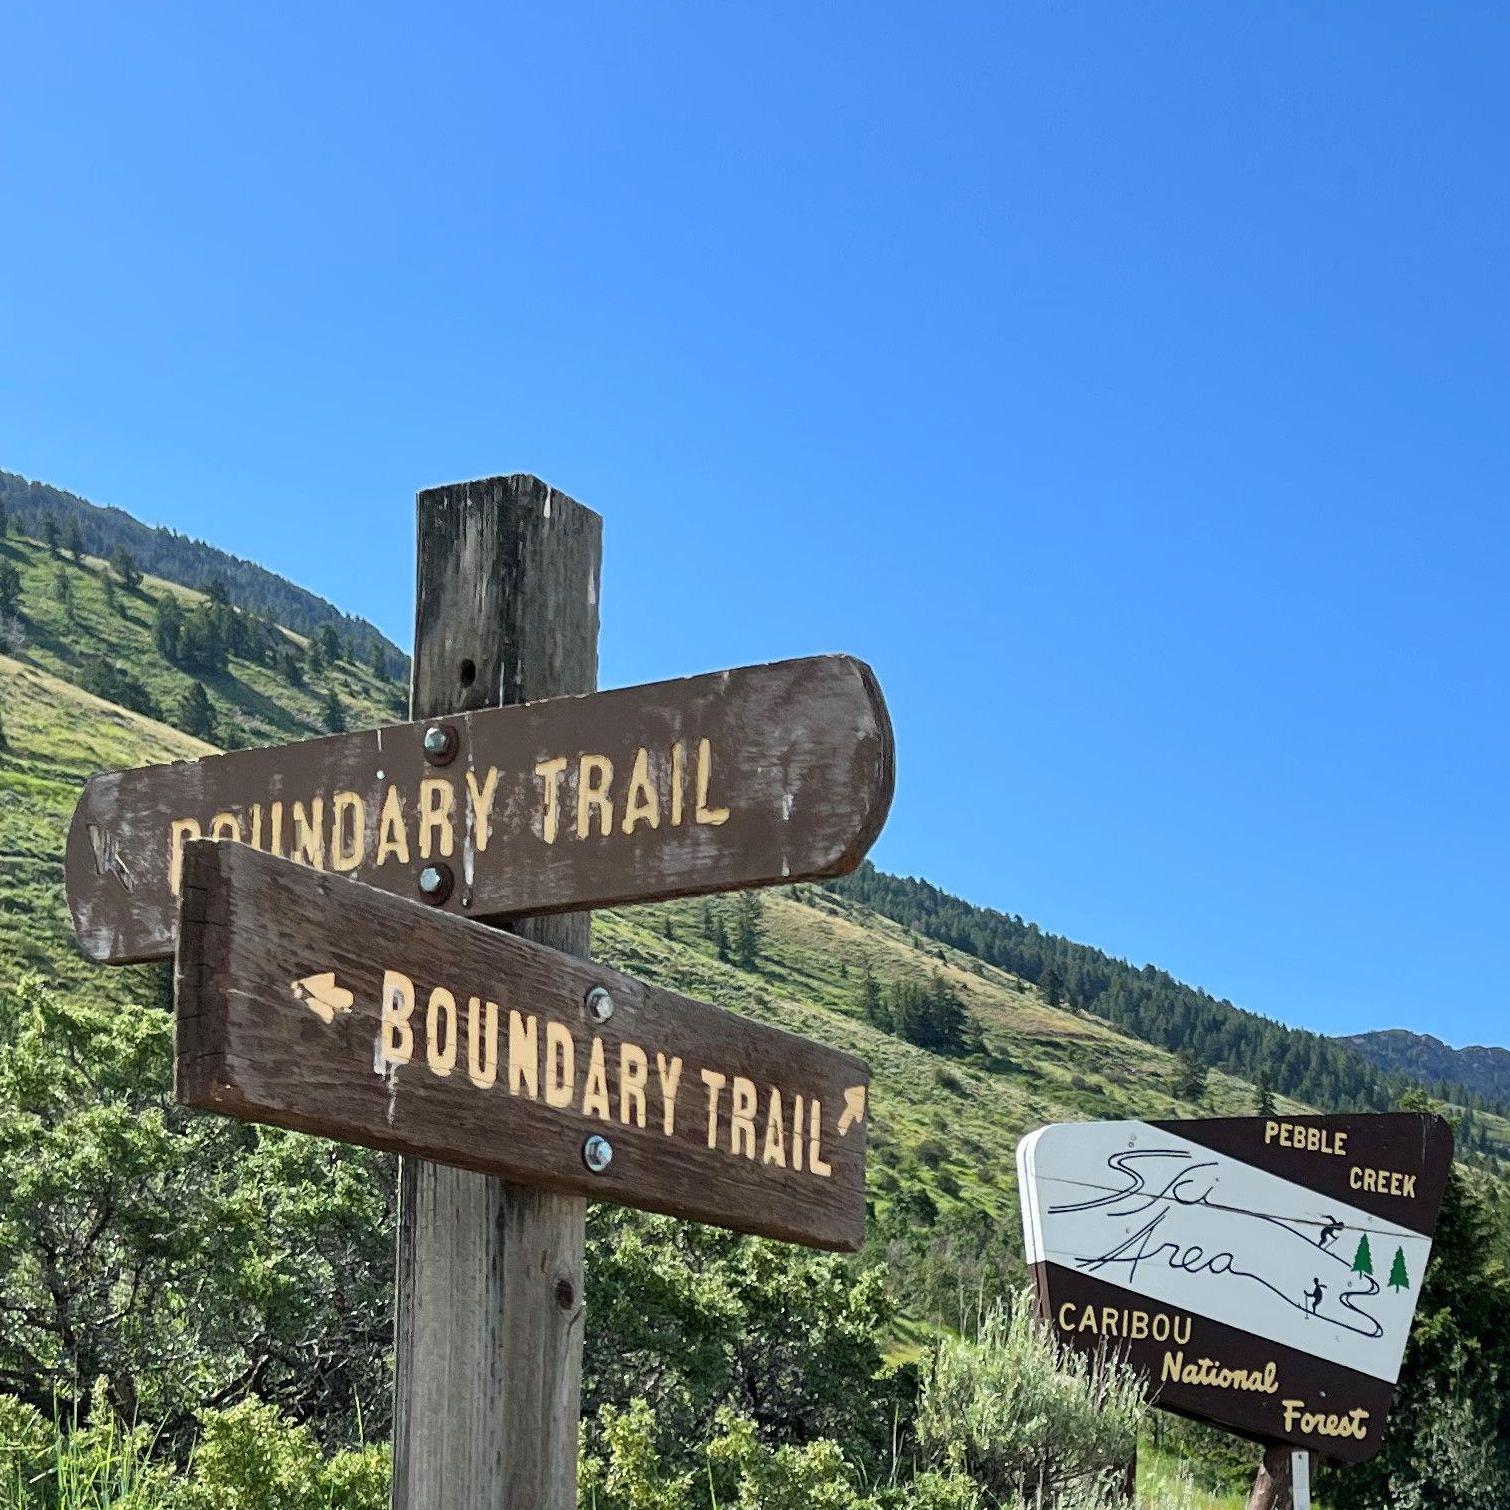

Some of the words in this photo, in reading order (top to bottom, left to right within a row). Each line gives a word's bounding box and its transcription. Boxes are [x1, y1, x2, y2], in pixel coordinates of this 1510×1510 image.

[535, 736, 731, 845] TRAIL
[380, 970, 682, 1136] BOUNDARY
[700, 1067, 833, 1177] TRAIL
[1265, 1121, 1348, 1156] PEBBLE
[1349, 1166, 1417, 1198] CREEK
[1075, 1206, 1236, 1283] Area
[1059, 1302, 1192, 1344] CARIBOU
[1161, 1352, 1279, 1394] National
[1281, 1400, 1370, 1439] Forest
